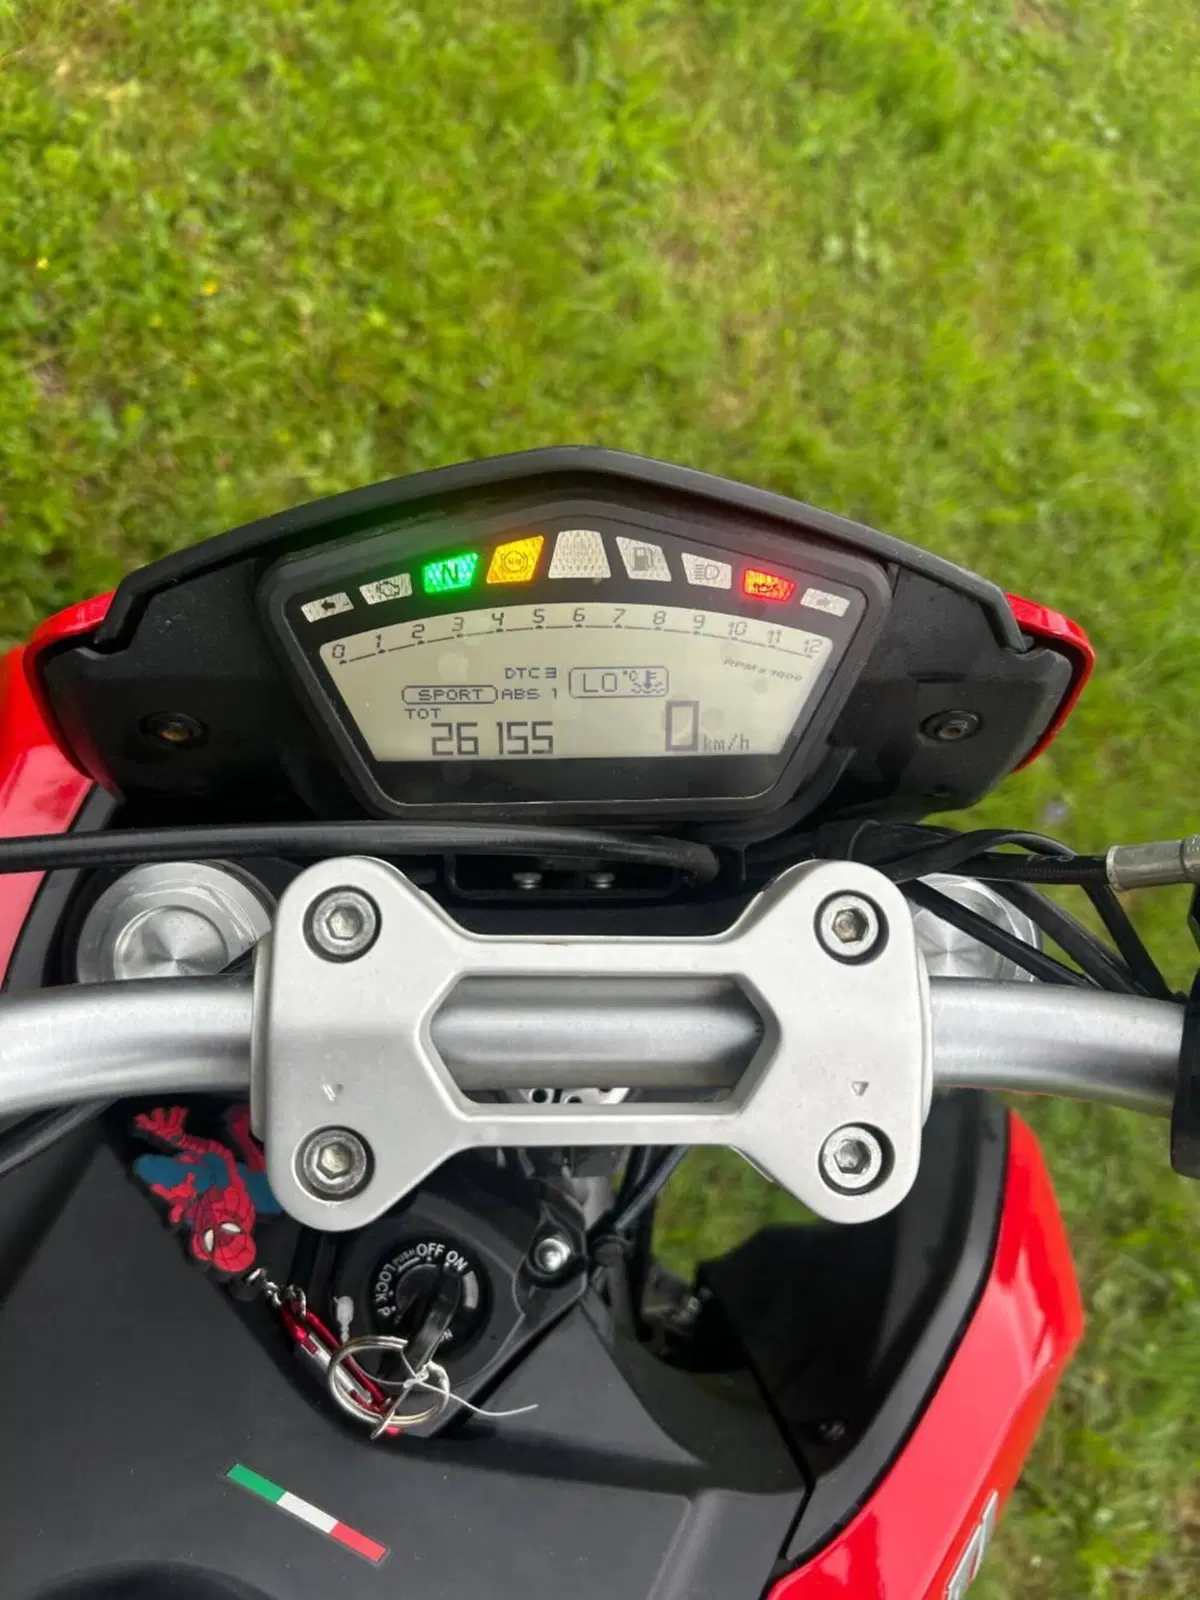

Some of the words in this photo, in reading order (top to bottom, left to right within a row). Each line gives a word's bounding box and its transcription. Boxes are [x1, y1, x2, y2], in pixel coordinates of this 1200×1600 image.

[332, 643, 346, 659] 0
[375, 634, 383, 648] 1
[411, 624, 425, 639] 2
[452, 617, 465, 632] 3
[492, 611, 504, 626] 4
[533, 608, 546, 623] 5
[573, 608, 586, 622] 6
[613, 608, 626, 623] 7
[653, 610, 666, 625] 8
[693, 614, 706, 628] 9
[728, 621, 748, 636] 10
[767, 629, 781, 644] 11
[803, 638, 823, 653] 12
[504, 667, 540, 680] DTC
[545, 667, 557, 679] 3
[418, 688, 484, 701] SPORT
[501, 688, 540, 700] ABS
[551, 688, 558, 699] 1
[404, 708, 441, 720] TOT
[665, 700, 700, 752] 0
[703, 733, 749, 751] km/h
[416, 1242, 446, 1257] OFF
[446, 1250, 468, 1272] ON
[375, 1263, 397, 1303] LOCK
[376, 1306, 391, 1316] P
